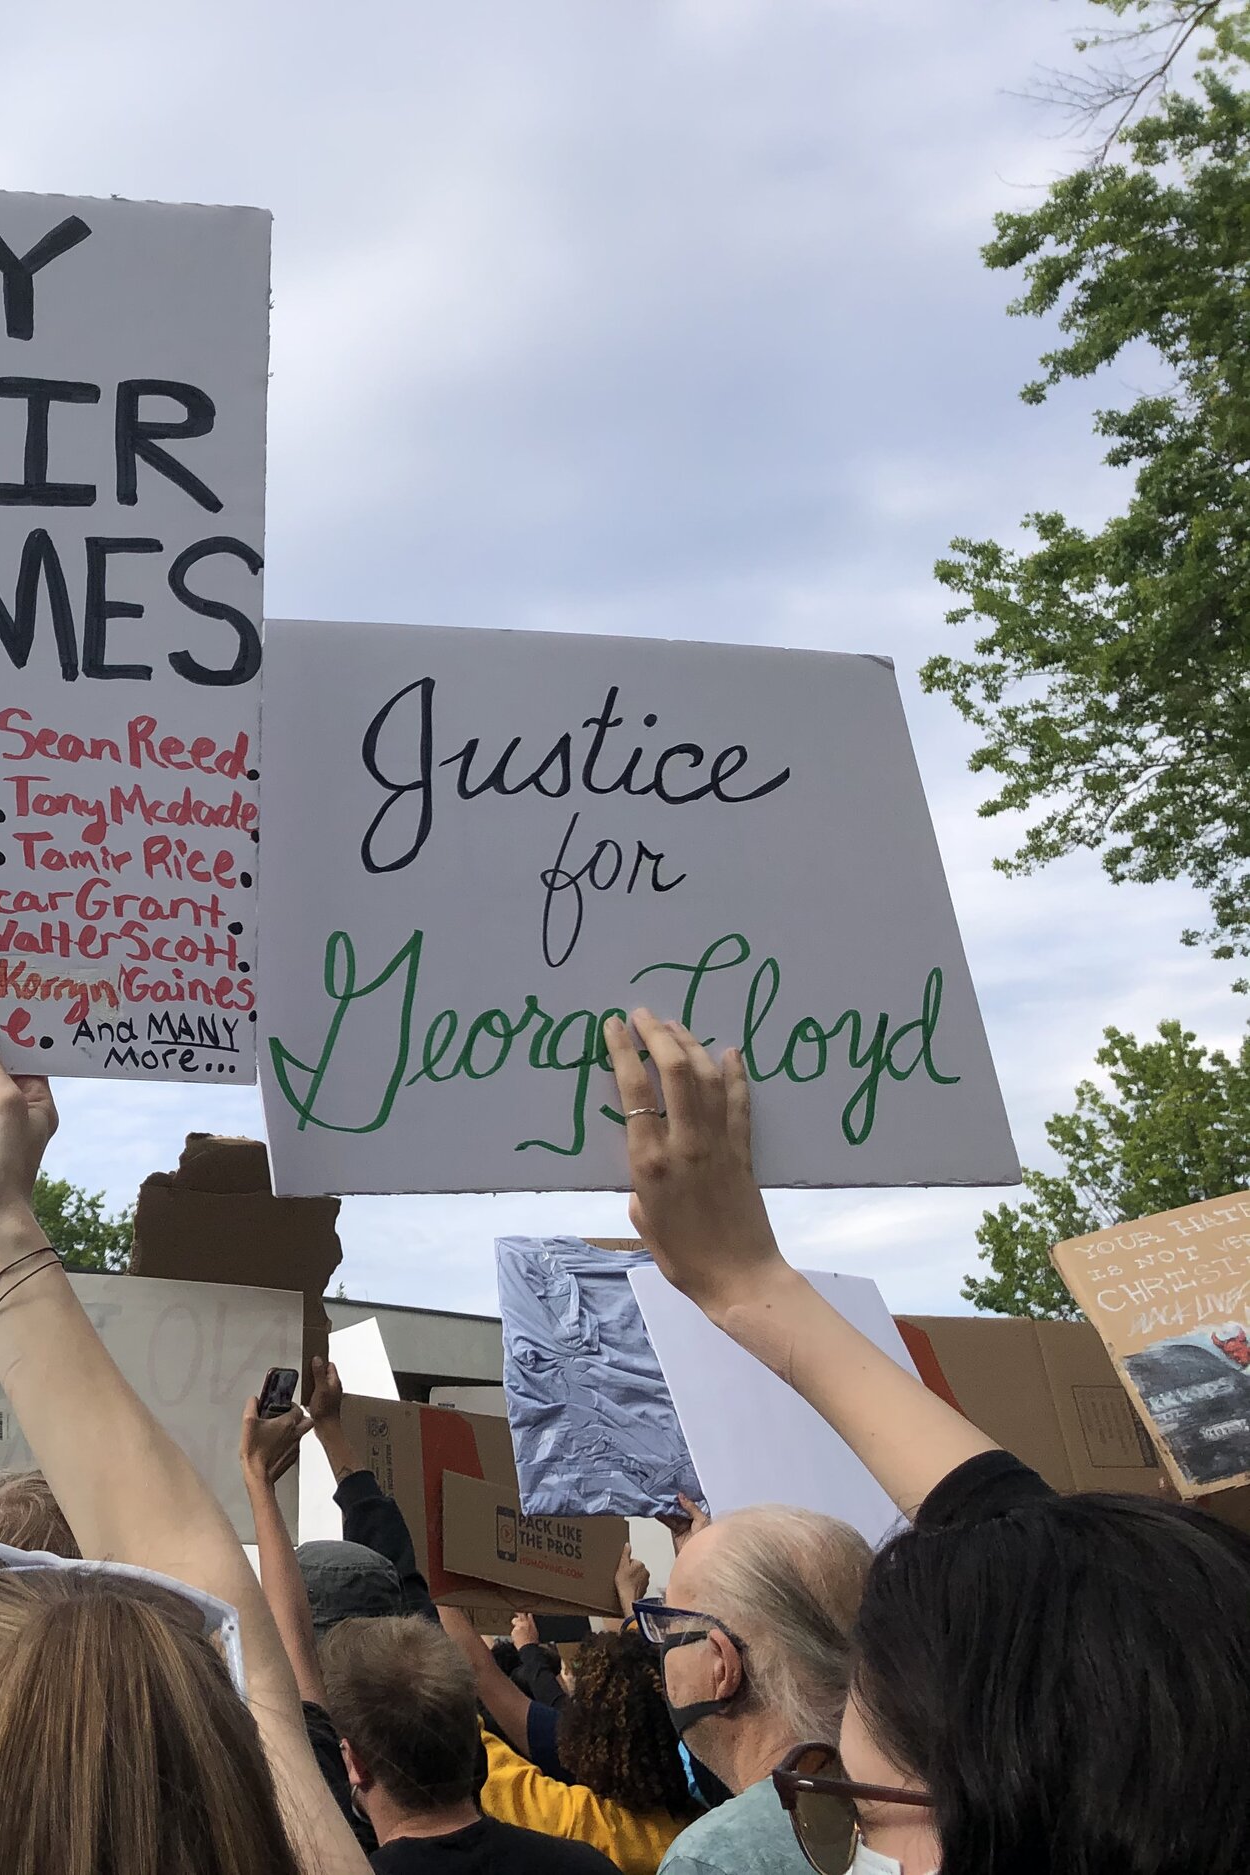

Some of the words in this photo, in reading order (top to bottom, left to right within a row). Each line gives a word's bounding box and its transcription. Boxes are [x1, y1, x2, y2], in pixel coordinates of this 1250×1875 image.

[360, 676, 791, 874] Justice
[3, 775, 110, 845] Tony
[12, 832, 132, 874] Tamir
[540, 812, 687, 968] for
[72, 1017, 138, 1046] And
[147, 1011, 239, 1049] MANY
[1074, 1231, 1166, 1260] YOUR
[1087, 1264, 1123, 1281] IS
[1134, 1245, 1200, 1270] NOT
[518, 1513, 552, 1535] PACK
[557, 1523, 582, 1543] LIKE
[518, 1529, 542, 1549] THE
[546, 1537, 582, 1559] PROS
